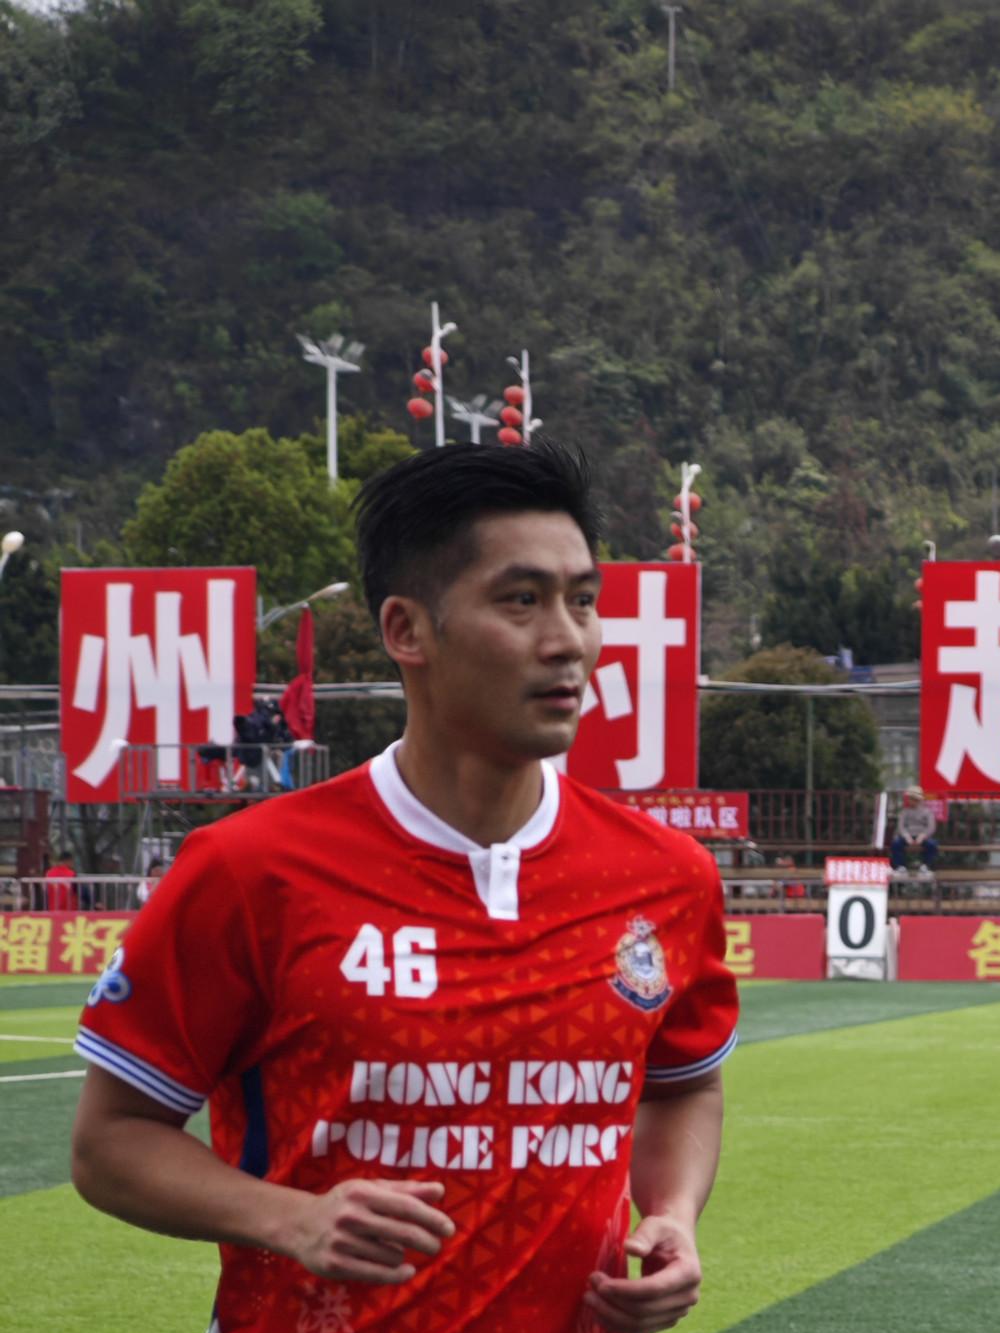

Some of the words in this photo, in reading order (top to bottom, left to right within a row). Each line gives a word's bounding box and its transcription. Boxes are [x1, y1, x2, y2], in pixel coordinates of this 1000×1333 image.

[73, 579, 236, 788] 州
[838, 895, 875, 950] 0
[340, 923, 438, 999] 46
[350, 1060, 491, 1106] HONG
[507, 1060, 633, 1105] KONG
[312, 1118, 494, 1170] POLICE
